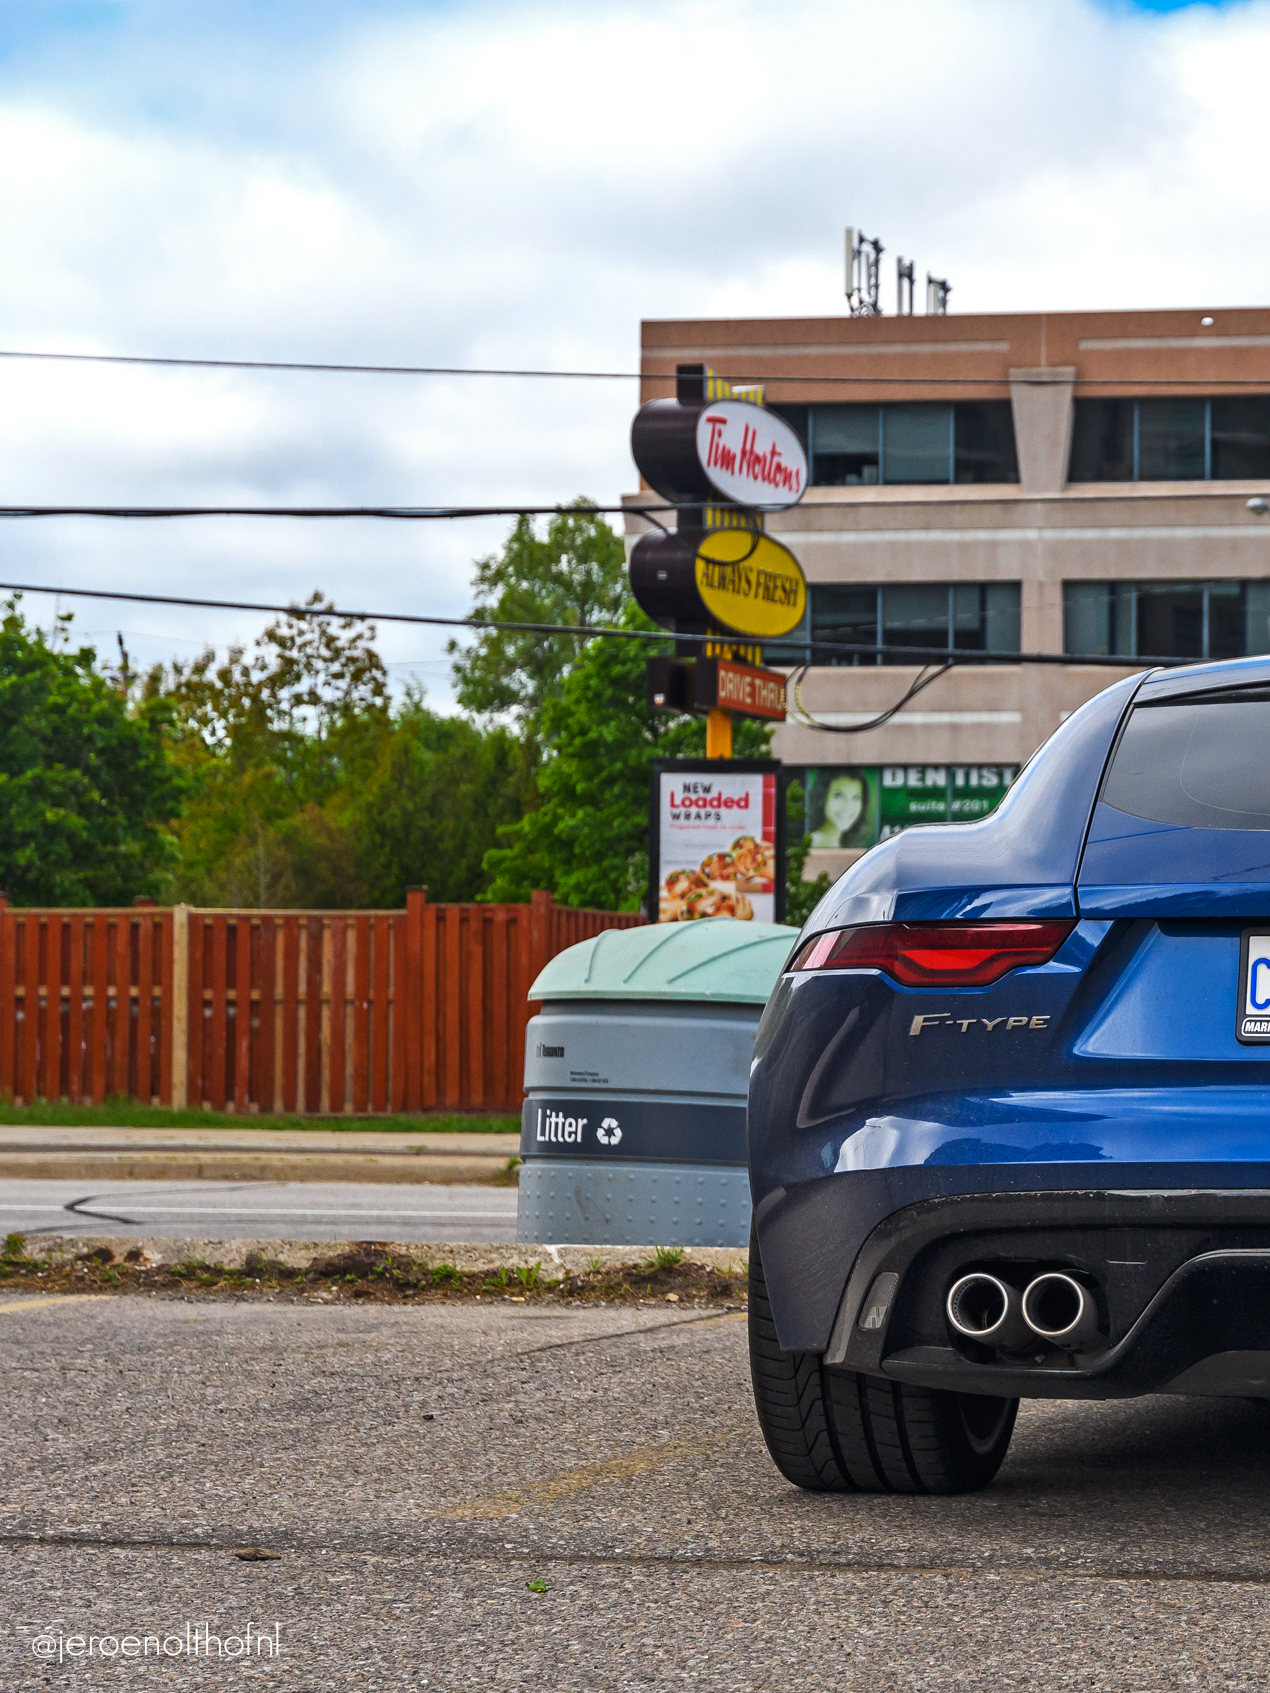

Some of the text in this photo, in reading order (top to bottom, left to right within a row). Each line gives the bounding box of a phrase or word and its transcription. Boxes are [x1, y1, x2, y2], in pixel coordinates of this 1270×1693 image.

[705, 415, 800, 494] Tim Hortons
[700, 558, 800, 607] ALWAYS FRESH
[718, 669, 752, 704] DRIVE
[682, 782, 713, 794] NEW
[882, 766, 1015, 788] DENTIST
[669, 790, 749, 809] Loaded
[670, 810, 722, 822] WRAPS
[909, 1012, 1051, 1036] F-TYPE
[536, 1108, 588, 1143] Litter
